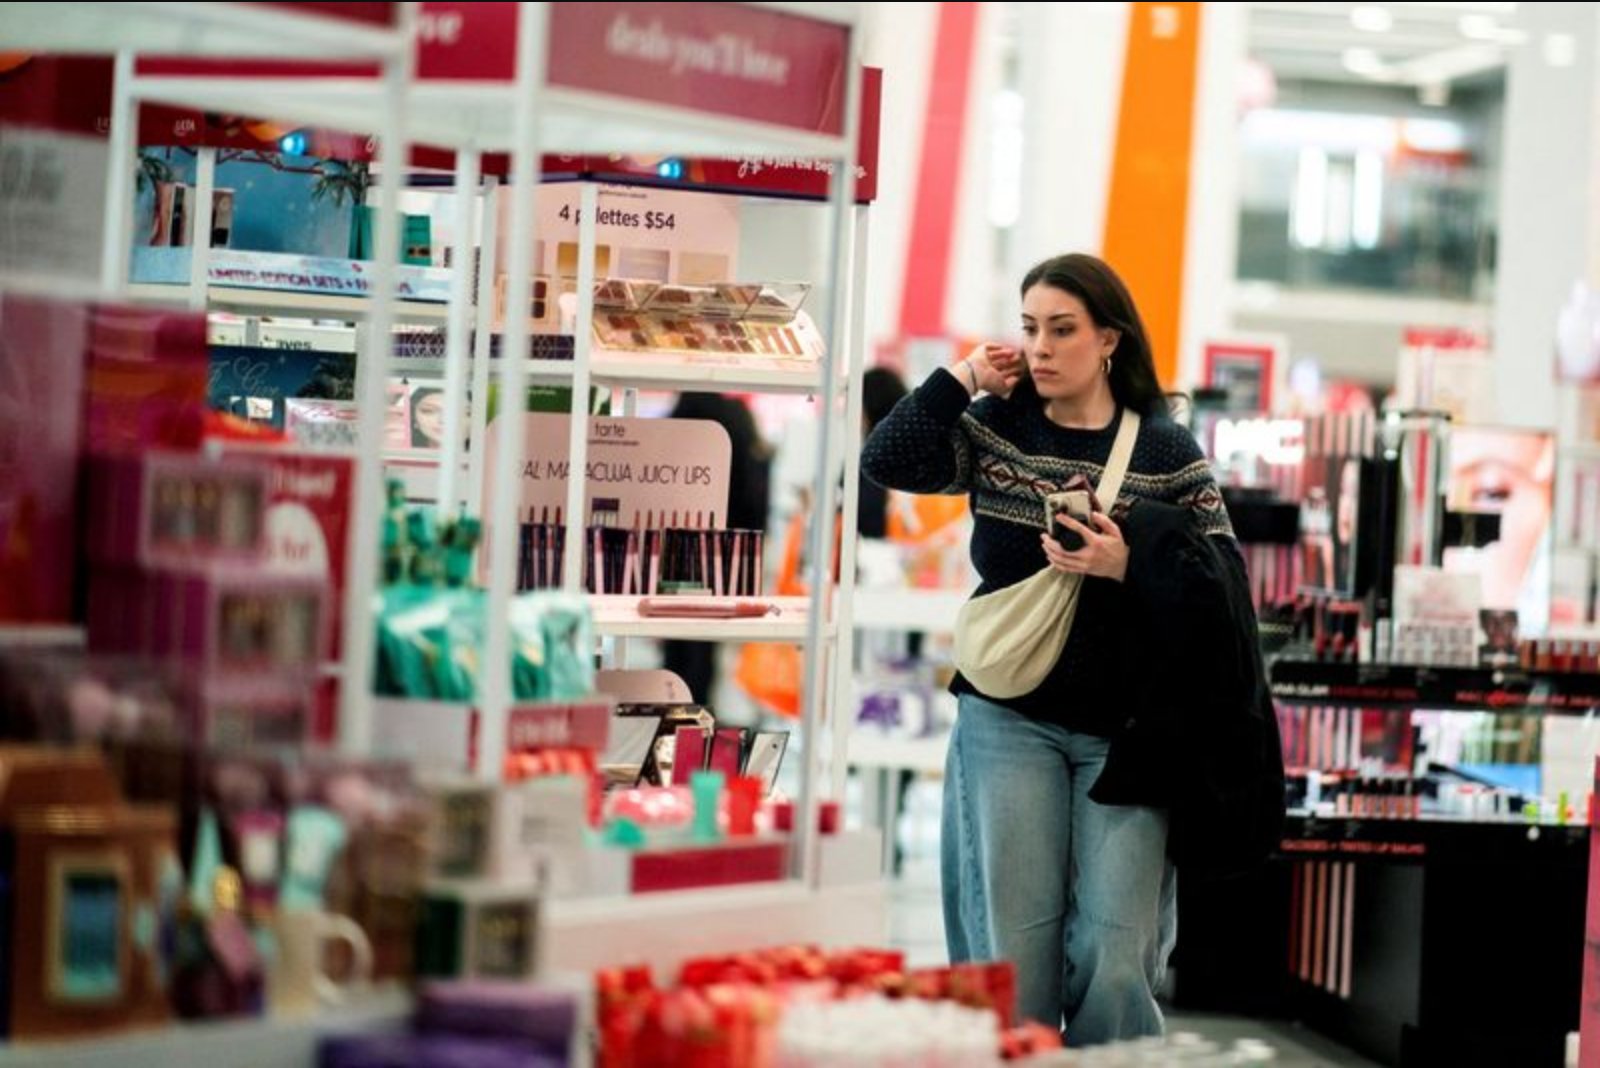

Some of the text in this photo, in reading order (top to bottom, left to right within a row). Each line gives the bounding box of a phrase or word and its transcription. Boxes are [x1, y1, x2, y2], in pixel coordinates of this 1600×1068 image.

[742, 37, 790, 85] love
[558, 204, 675, 230] 4 plettes $54
[312, 275, 344, 289] SETS
[595, 423, 625, 437] tarte
[521, 460, 712, 485] AL MAACUJA JUICY LIPS
